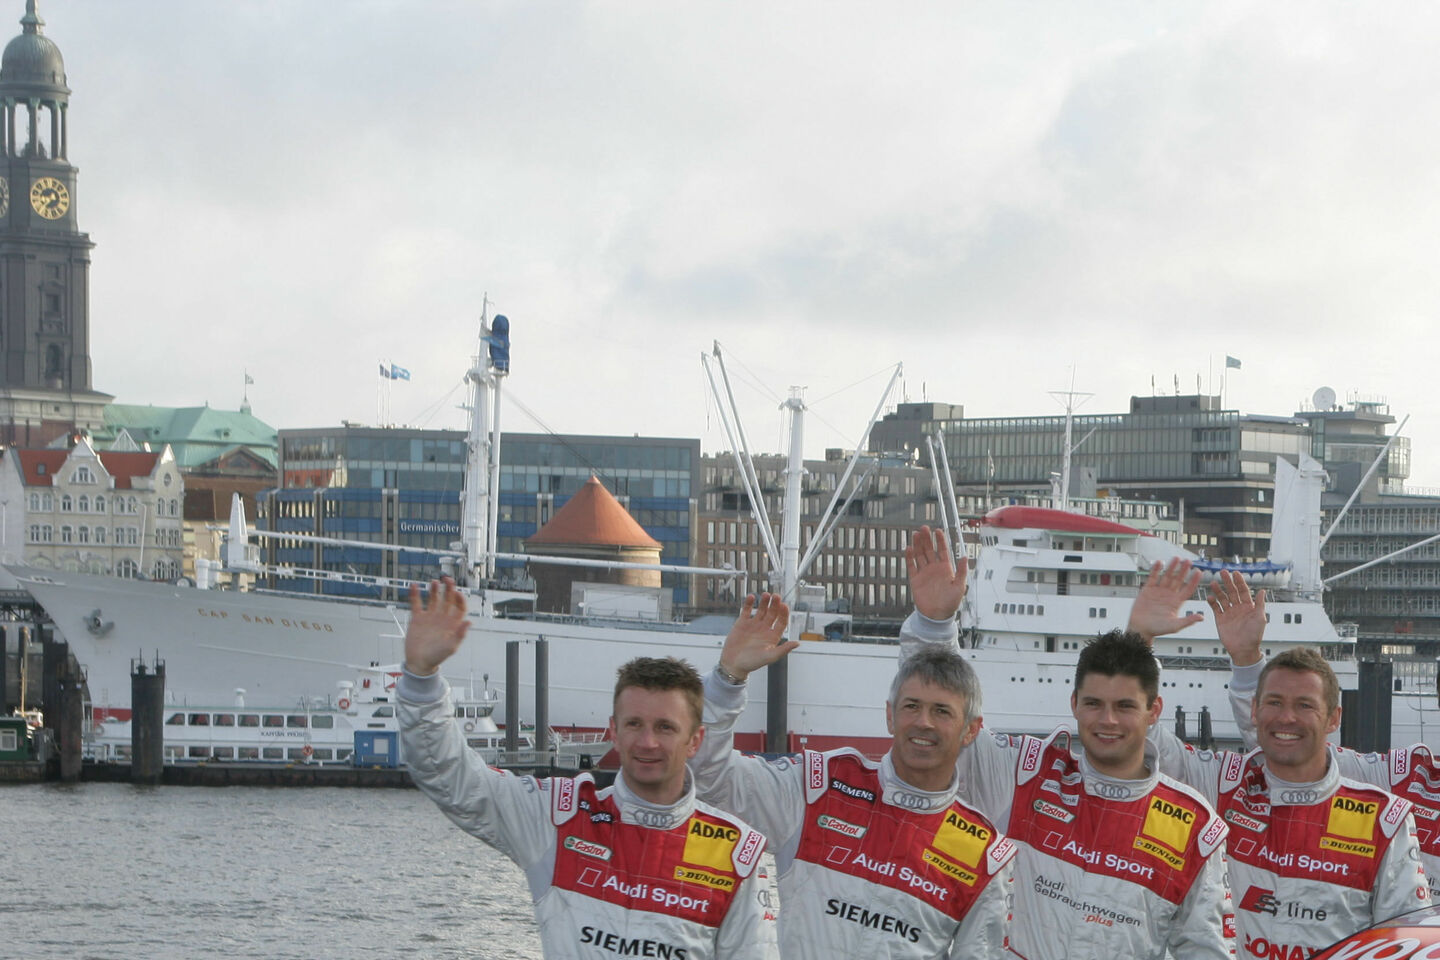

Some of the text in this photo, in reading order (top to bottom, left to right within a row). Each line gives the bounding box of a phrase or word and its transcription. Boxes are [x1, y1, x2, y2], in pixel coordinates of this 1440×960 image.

[400, 521, 460, 533] Germanischer
[197, 607, 334, 632] CAP SAN DIEGO
[812, 753, 824, 788] sparco
[832, 780, 875, 801] SIEMENS
[1042, 803, 1069, 821] Castrol
[1151, 799, 1194, 825] ADAC
[1333, 797, 1376, 815] ADAC
[690, 820, 739, 842] ADAC
[827, 818, 860, 836] Castrol
[945, 813, 988, 842] ADAC
[1232, 812, 1262, 830] Castrol
[574, 840, 607, 858] Castrol
[738, 832, 760, 864] sparco
[1063, 840, 1155, 880] Audi Sport
[1143, 842, 1183, 867] DUNLOP
[1330, 841, 1373, 854] DUNLOP
[931, 856, 975, 882] DUNLOP
[1258, 845, 1350, 876] Audi Sport
[684, 870, 733, 888] DUNLOP
[852, 852, 949, 901] Audi Sport
[1035, 875, 1065, 892] Audi
[602, 875, 710, 914] Audi Sport
[1034, 883, 1142, 927] Gebrauchtwagen
[825, 898, 922, 943] SIEMENS
[1287, 902, 1327, 922] line
